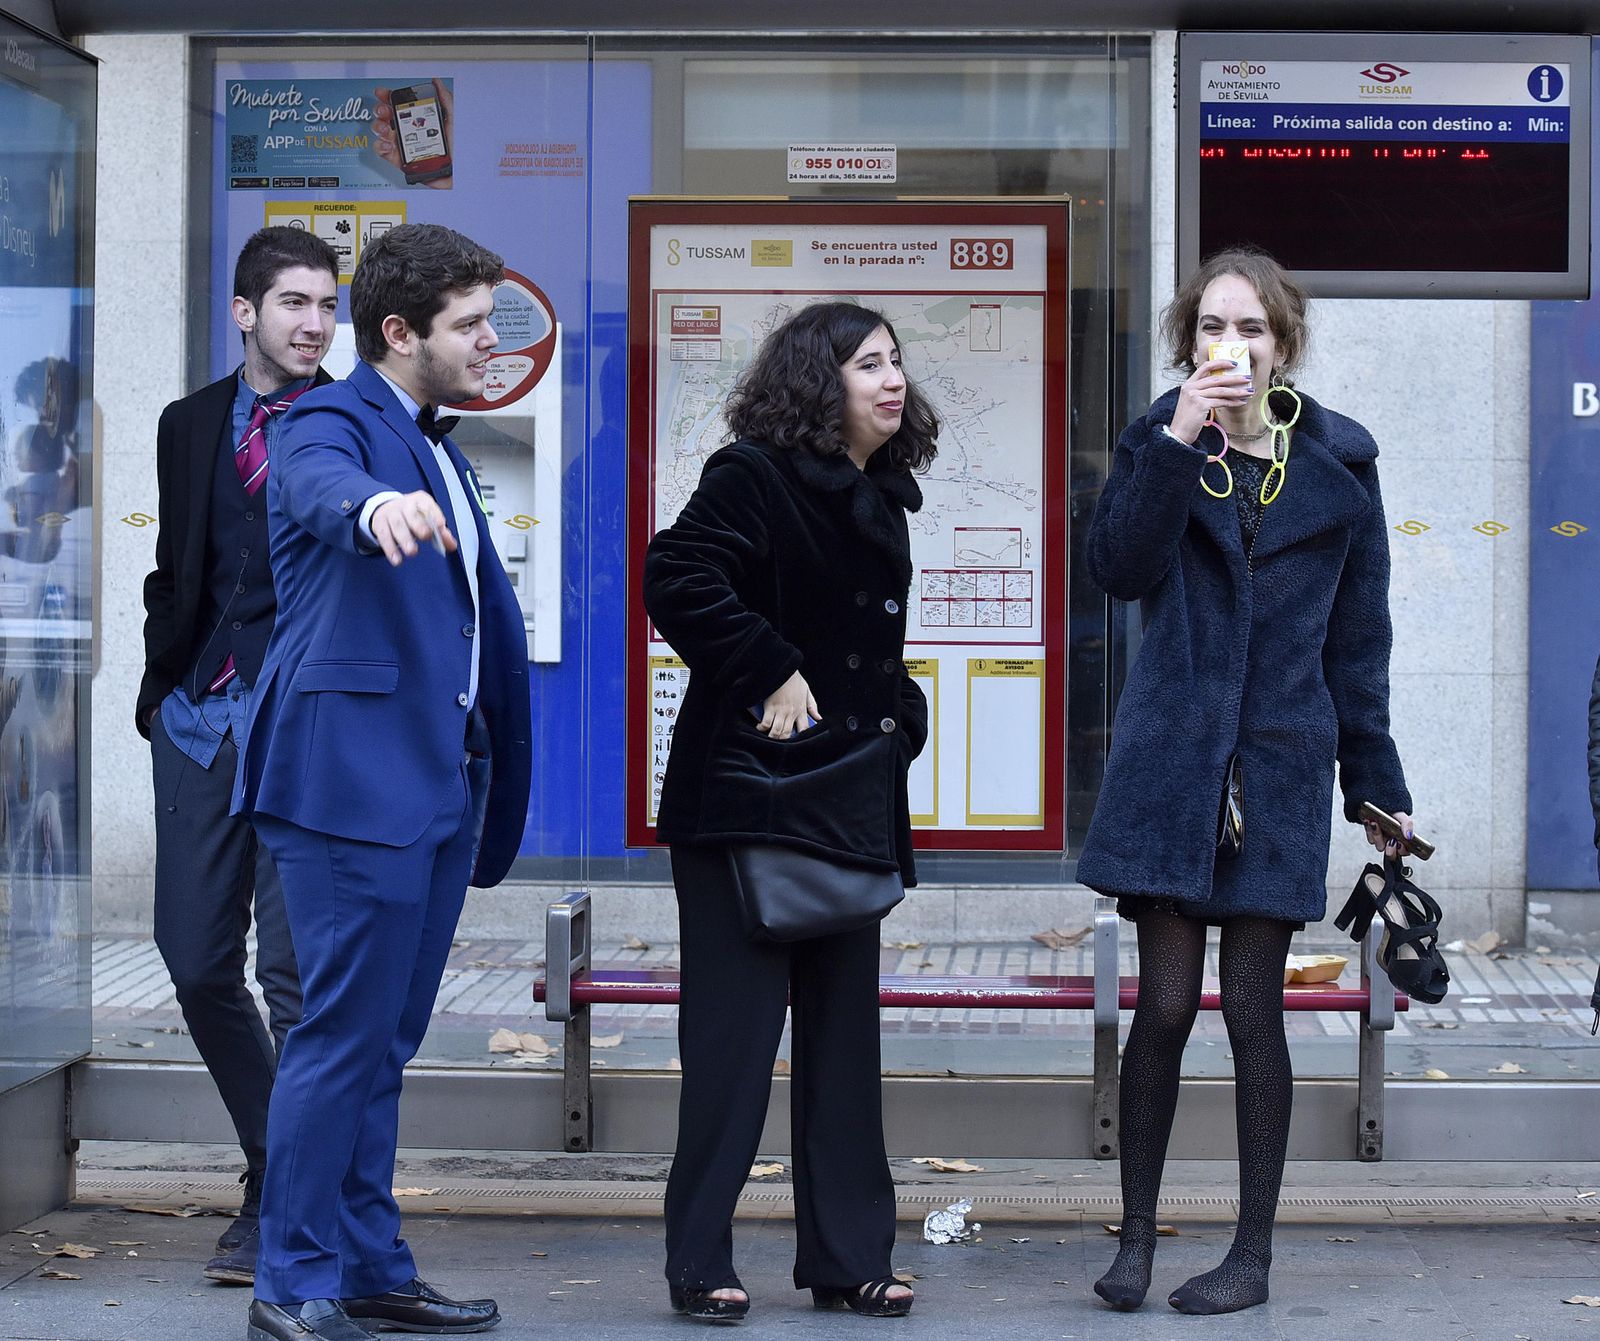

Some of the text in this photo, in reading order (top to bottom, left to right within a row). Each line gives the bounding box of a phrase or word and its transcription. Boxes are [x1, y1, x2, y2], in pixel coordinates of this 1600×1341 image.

[1208, 80, 1280, 89] AYUNTAMIENTO
[1359, 86, 1412, 94] TUSSAM
[230, 83, 303, 108] Muévete
[1234, 91, 1269, 100] SEVILLA
[268, 97, 372, 129] por Sevilla
[1208, 114, 1564, 132] Línea: Próxima salida con destino a: Min:
[263, 136, 294, 149] APP
[305, 135, 369, 149] TUSSAM
[806, 159, 832, 169] 955
[837, 159, 863, 169] 010
[811, 241, 938, 251] Se encuentra usted
[687, 247, 745, 259] TUSSAM
[953, 242, 1009, 267] 889
[824, 256, 839, 265] en
[844, 255, 855, 265] la
[859, 255, 904, 267] parada
[1573, 382, 1600, 416] B
